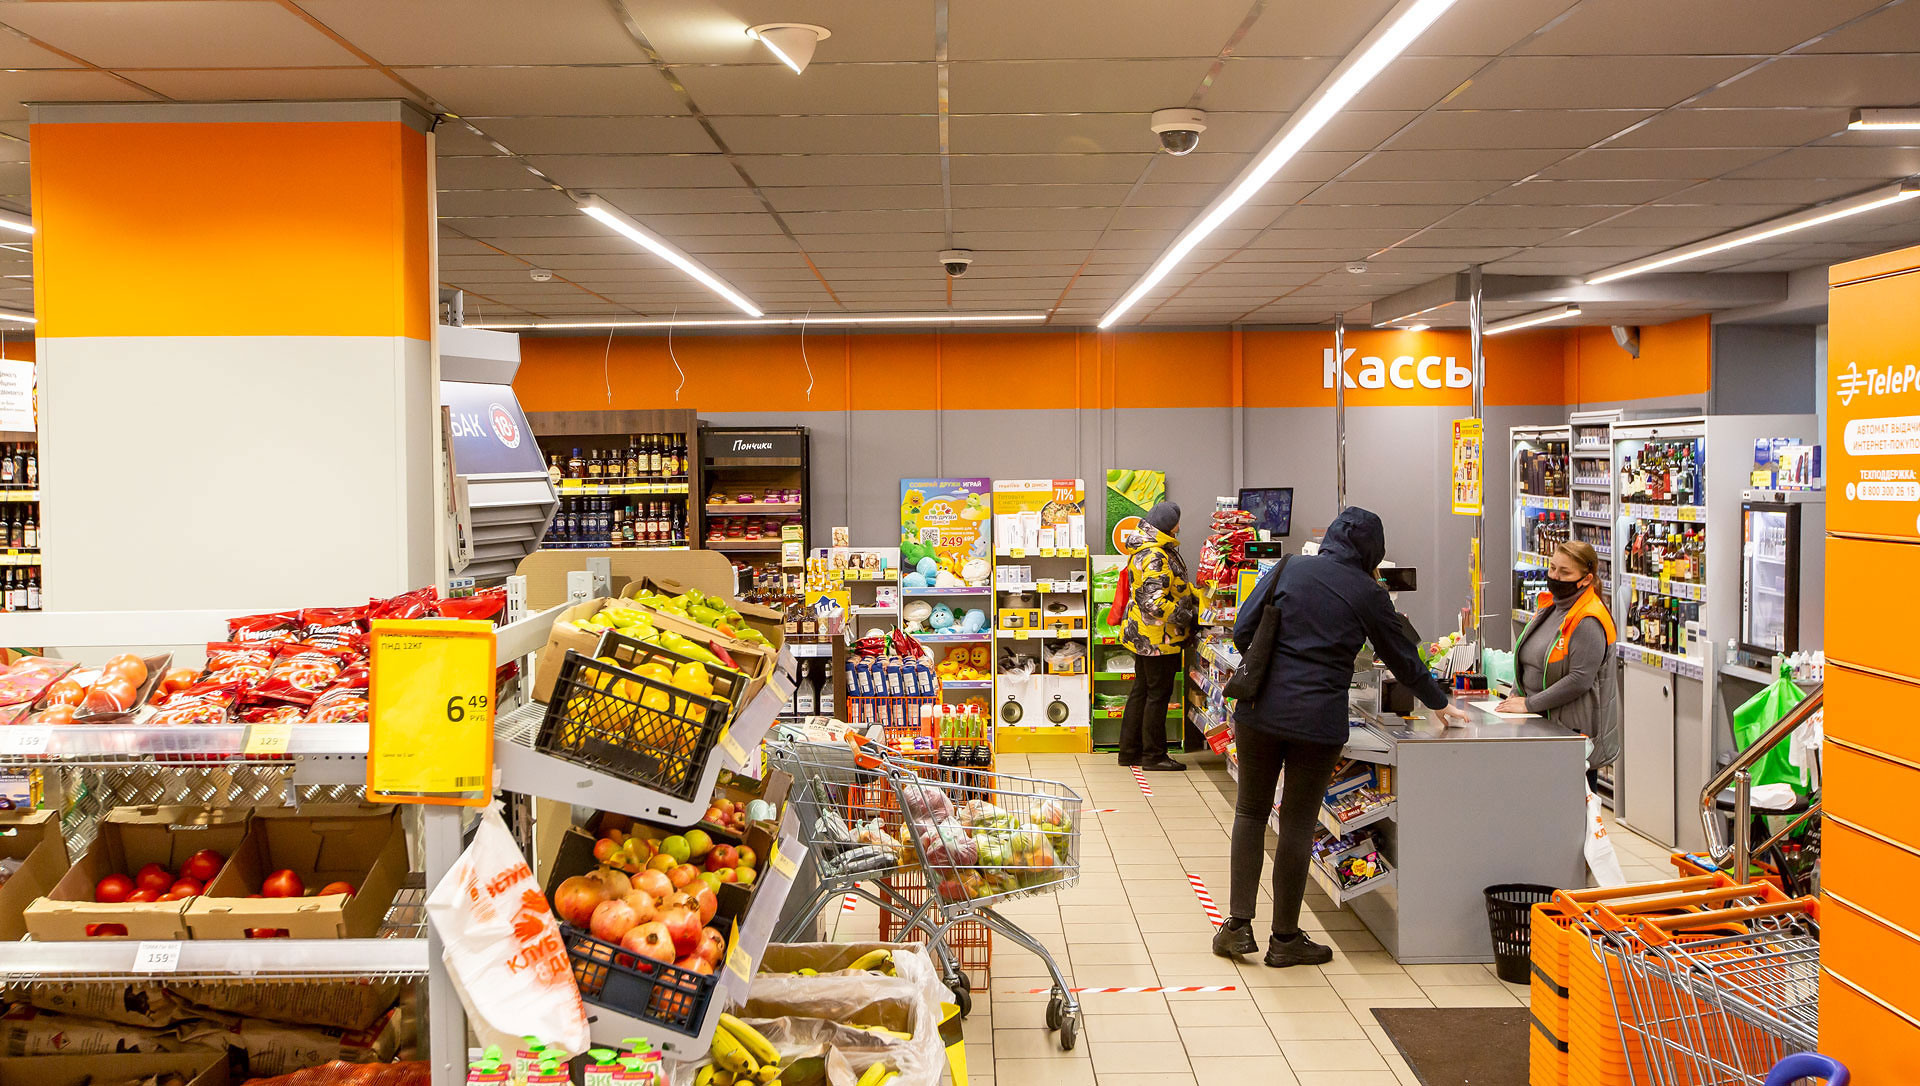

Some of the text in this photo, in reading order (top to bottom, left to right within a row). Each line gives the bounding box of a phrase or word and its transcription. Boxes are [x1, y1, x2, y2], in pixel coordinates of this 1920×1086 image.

[1323, 347, 1485, 388] Кассы
[1857, 423, 1888, 435] АВТОМАТ
[732, 439, 773, 451] Пончики
[1860, 469, 1917, 481] ТЕХПОДДЕРЖКА:
[1055, 488, 1074, 501] 71%
[1868, 486, 1880, 496] 800
[1882, 486, 1894, 496] 300
[941, 536, 963, 547] 249
[309, 623, 361, 636] Flamenco
[403, 642, 422, 650] 12КГ
[447, 695, 488, 723] 6 49
[260, 737, 278, 745] 129
[147, 953, 169, 962] 159
[507, 934, 559, 974] КЛУБ
